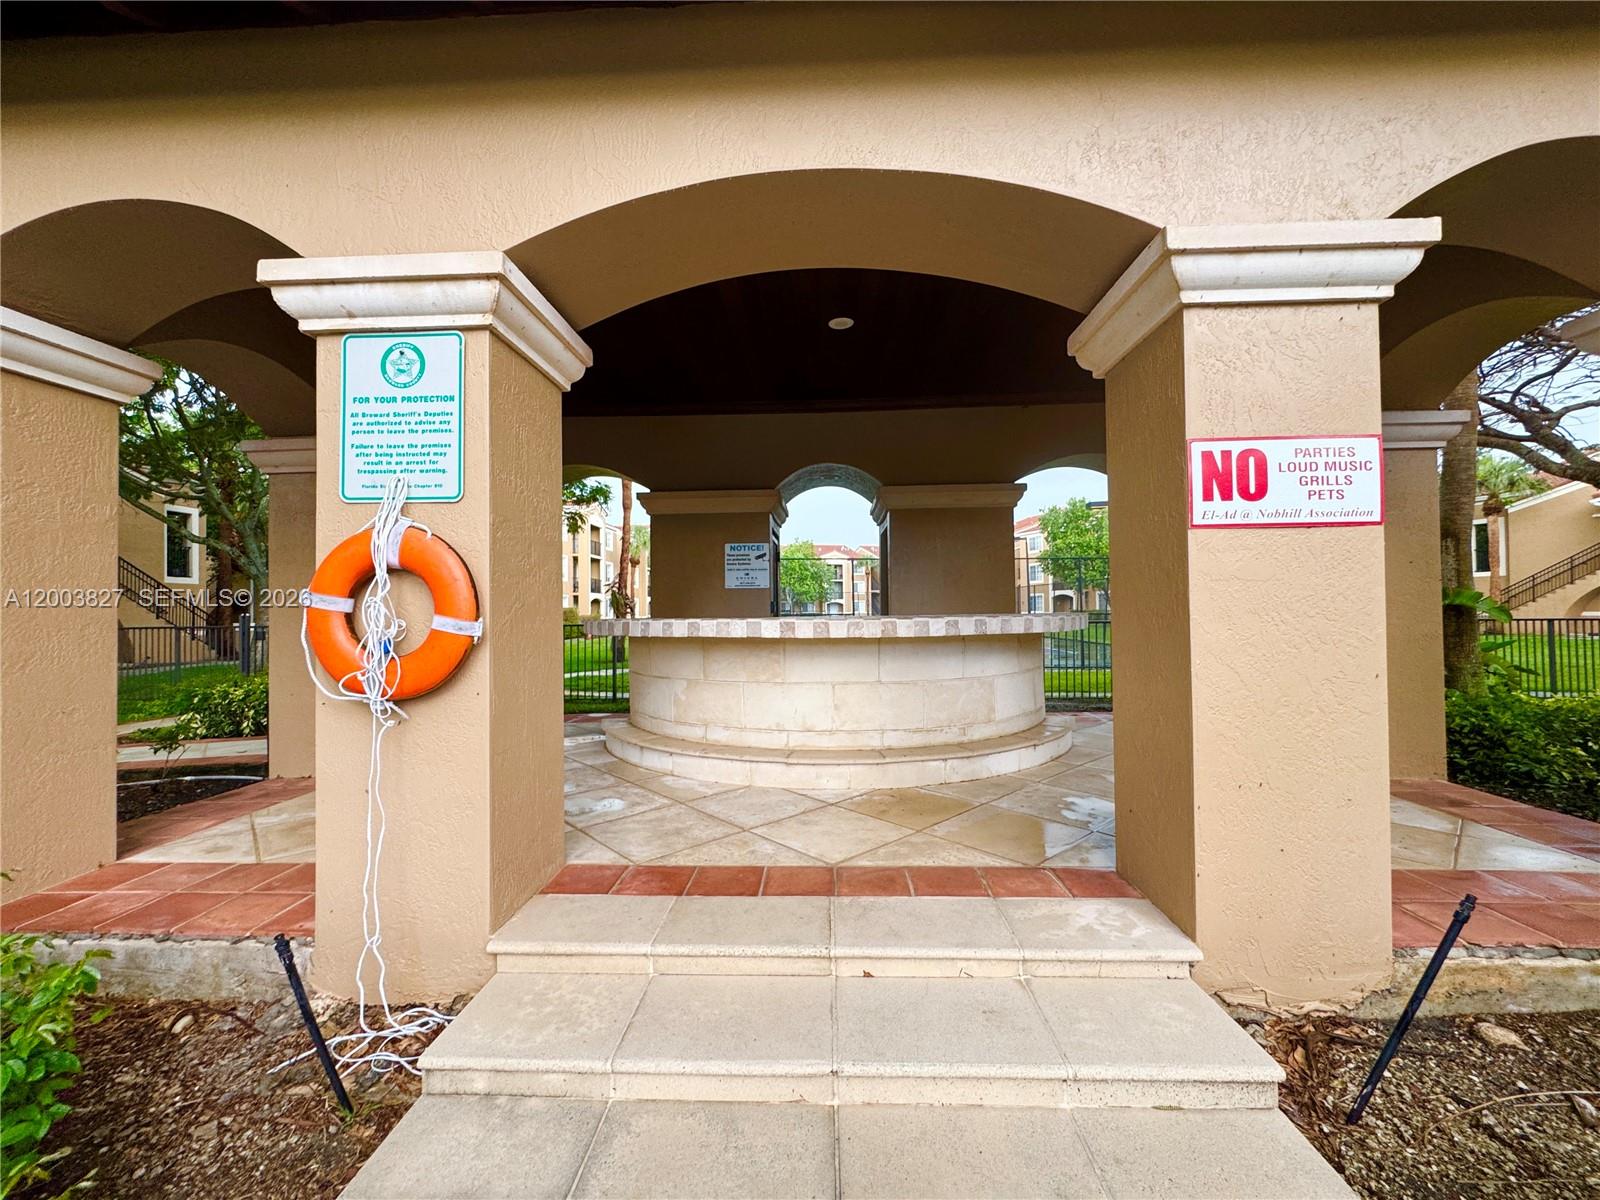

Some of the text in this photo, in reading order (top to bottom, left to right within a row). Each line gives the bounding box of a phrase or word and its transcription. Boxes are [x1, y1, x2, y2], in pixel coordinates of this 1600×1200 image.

[352, 395, 455, 404] FOR YOUR PROTECTION
[1294, 446, 1356, 458] PARTIES
[419, 467, 448, 475] warning.
[1278, 460, 1373, 473] LOUD MUSIC
[1200, 447, 1269, 502] NO
[1299, 475, 1353, 487] GRILLS
[1307, 489, 1345, 500] PETS
[1201, 507, 1374, 520] El-Ad @ Nobhill Association
